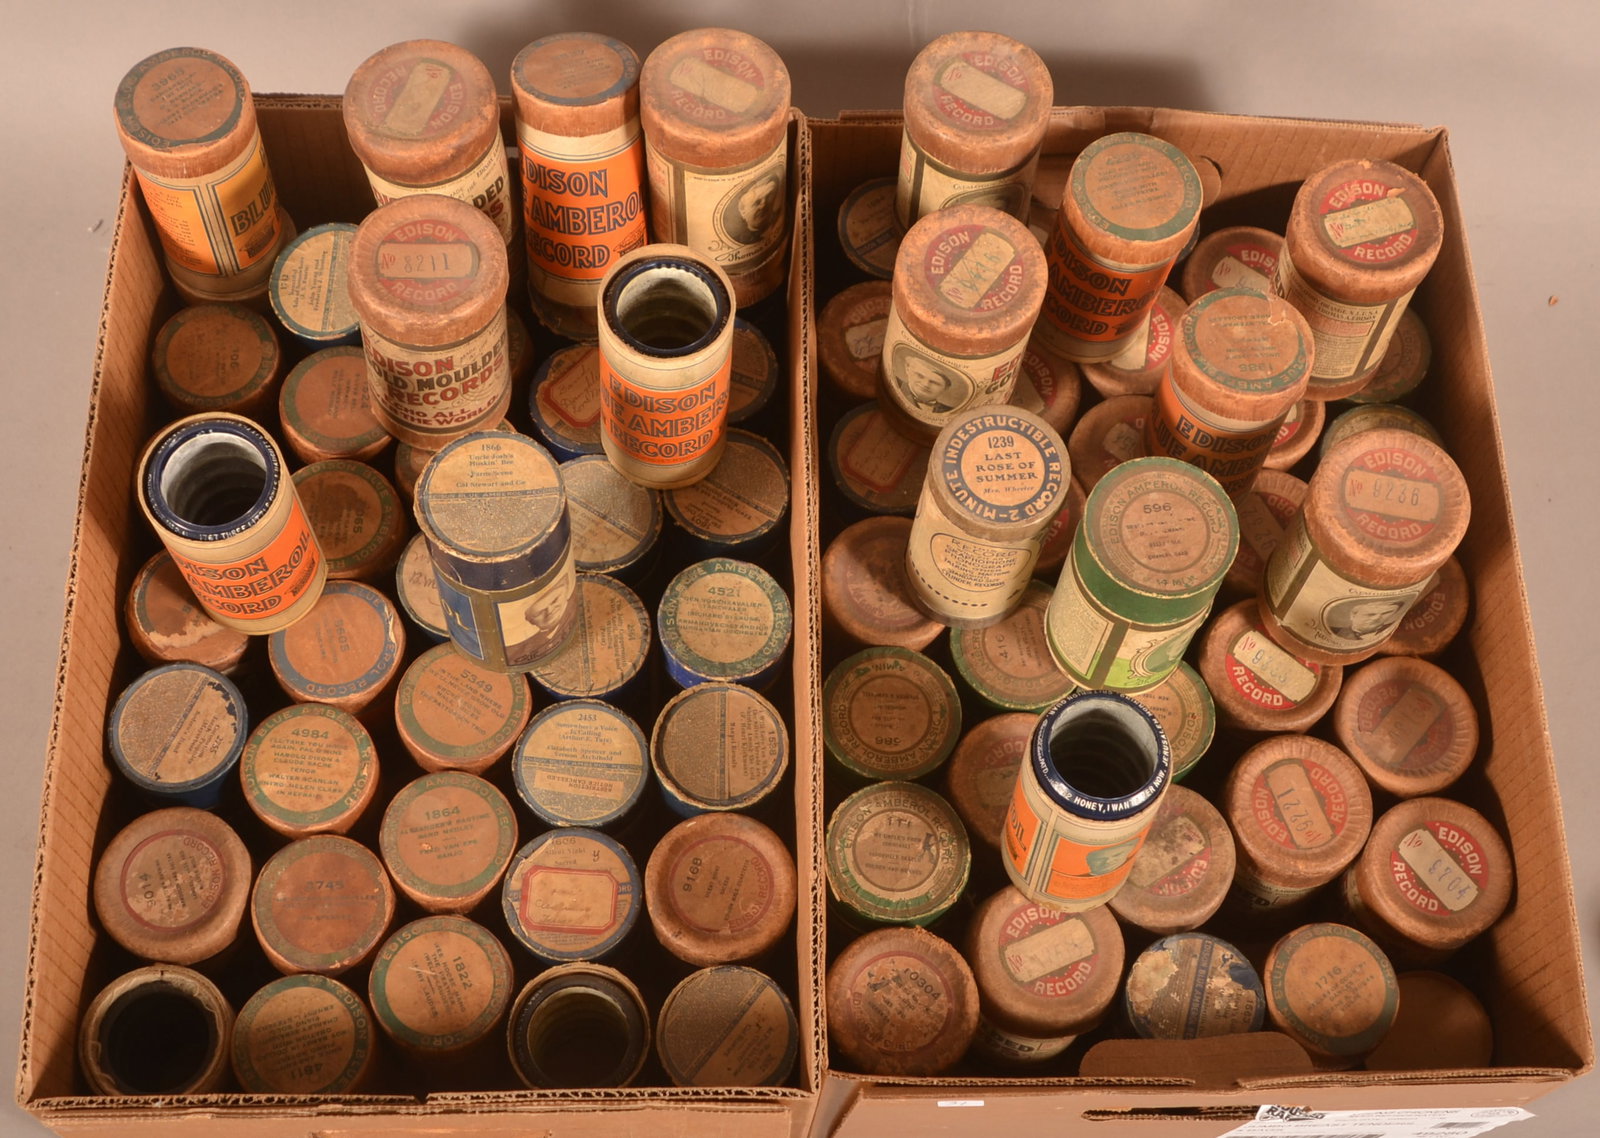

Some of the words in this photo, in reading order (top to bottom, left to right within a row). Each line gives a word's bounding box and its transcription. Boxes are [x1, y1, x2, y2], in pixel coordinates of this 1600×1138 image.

[703, 49, 758, 80] EDISON
[974, 55, 1026, 86] EDISON
[373, 66, 406, 114] RECORD
[431, 82, 463, 129] EDISON
[672, 90, 727, 120] RECORD
[941, 94, 994, 127] RECORD
[230, 184, 275, 237] BLU
[1329, 182, 1385, 209] EDISON
[394, 223, 459, 243] EDISON
[1354, 234, 1412, 260] RECORD
[403, 252, 451, 274] 8211
[931, 231, 971, 275] EDISON
[1056, 239, 1132, 296] DISON
[1241, 250, 1277, 271] EDIS
[391, 281, 457, 301] RECORD
[982, 263, 1023, 311] RECORD
[1051, 262, 1154, 317] AMBERO
[1149, 313, 1171, 361] EDISON
[609, 374, 716, 415] EDISON
[433, 408, 470, 419] ALL
[628, 390, 729, 439] AMBER
[609, 422, 714, 459] RECORD
[985, 452, 1022, 461] LAST
[988, 436, 1015, 449] 1239
[946, 415, 1057, 465] INDESTRUCTIBLE
[1026, 462, 1062, 516] RECORD
[975, 462, 1015, 472] ROSE
[1019, 461, 1037, 470] OF
[975, 472, 1038, 483] SUMMER
[1364, 453, 1426, 477] EDISON
[1111, 497, 1127, 546] EDISON
[1143, 502, 1172, 514] 596
[1356, 512, 1423, 539] RECORD
[176, 556, 270, 582] DISON
[708, 587, 742, 598] 4521
[458, 667, 495, 695] 5349
[1232, 666, 1283, 706] RECORD
[290, 728, 330, 740] 4984
[839, 704, 860, 748] RECORD
[290, 767, 317, 775] TENOR
[862, 749, 916, 764] AMBEROL
[1074, 796, 1106, 814] HONEY,
[1152, 717, 1169, 766] JERUSALEM
[268, 773, 300, 781] WALTER
[875, 799, 931, 820] AMBEROL
[1311, 767, 1345, 824] RECORD
[425, 806, 461, 820] 1864
[1255, 787, 1288, 844] EDISON
[183, 836, 217, 867] RECORD
[1438, 825, 1483, 875] EDISON
[682, 857, 703, 893] 9168
[751, 856, 769, 896] RECORD
[1393, 860, 1439, 912] RECORD
[1006, 905, 1062, 938] EDISON
[451, 955, 473, 990] 1822
[1034, 960, 1092, 996] RECORD
[1274, 959, 1288, 1001] BLUE
